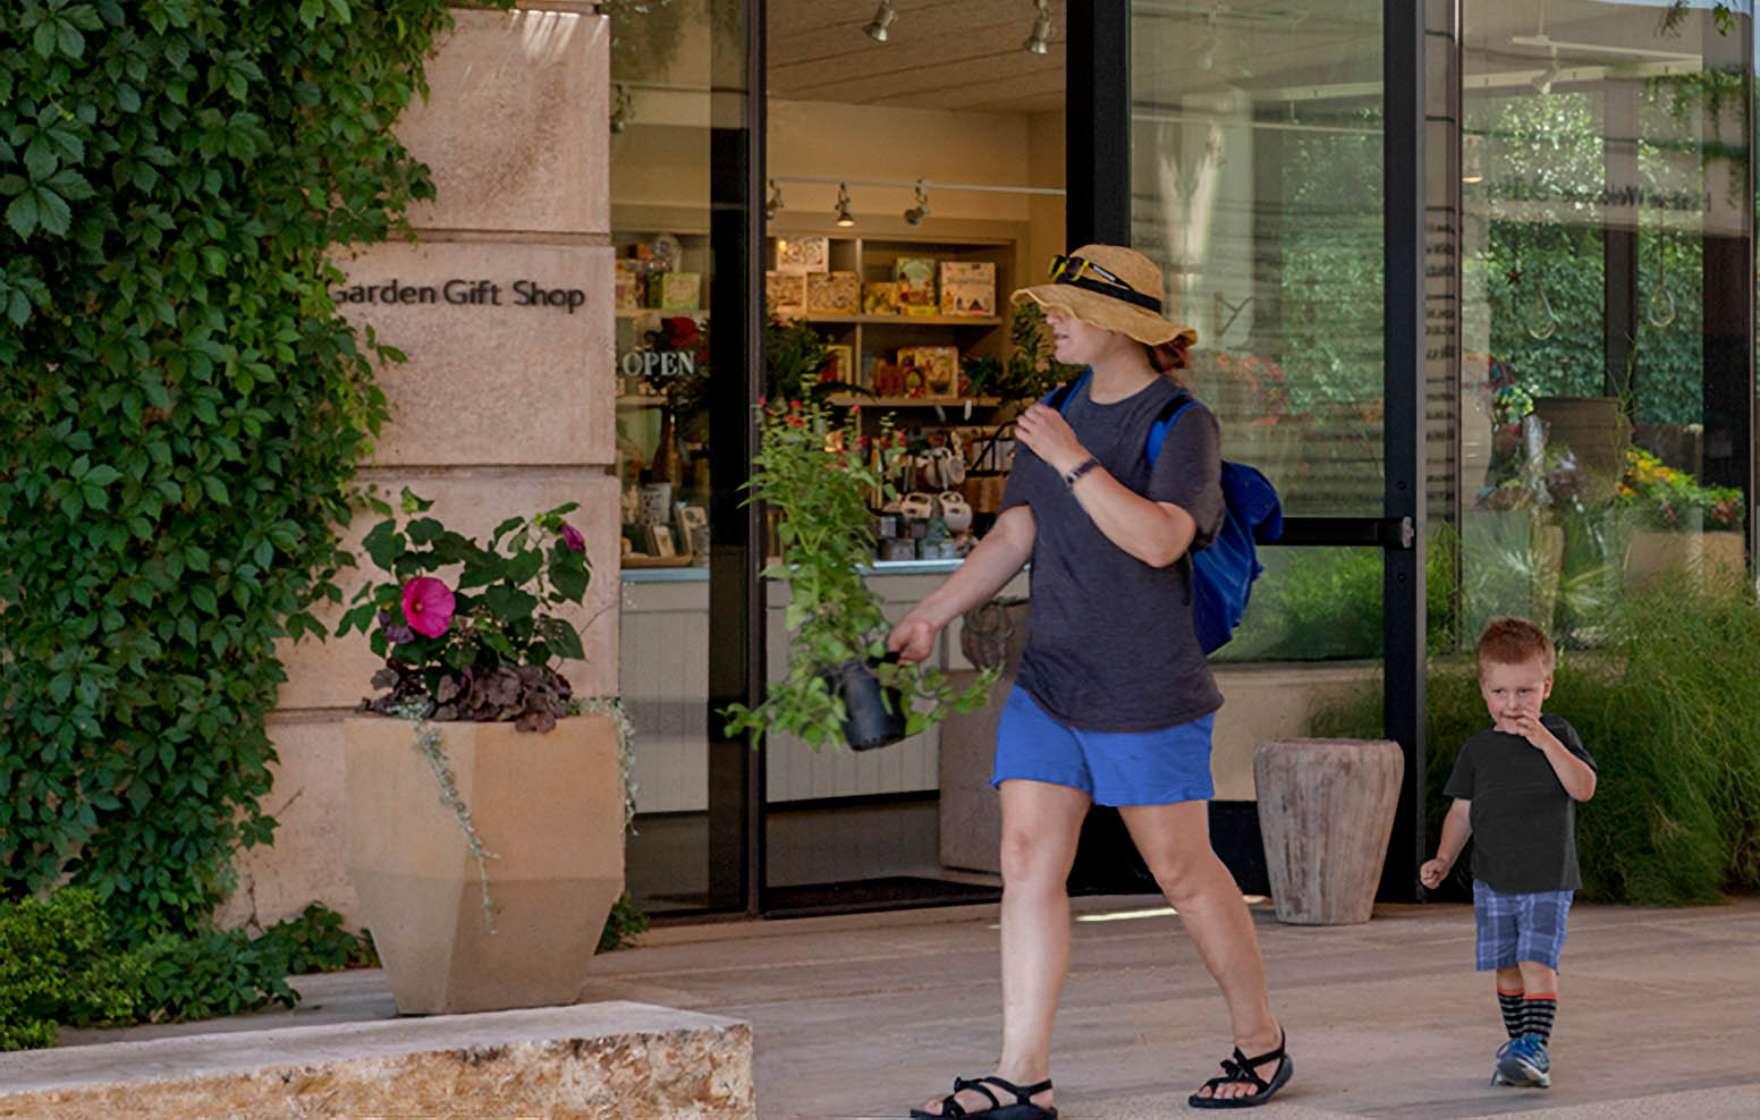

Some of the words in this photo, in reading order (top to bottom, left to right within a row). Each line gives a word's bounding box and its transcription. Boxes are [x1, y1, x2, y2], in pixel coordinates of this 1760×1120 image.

[442, 279, 502, 306] Gift
[512, 280, 585, 314] Shop
[621, 350, 696, 377] OPEN
